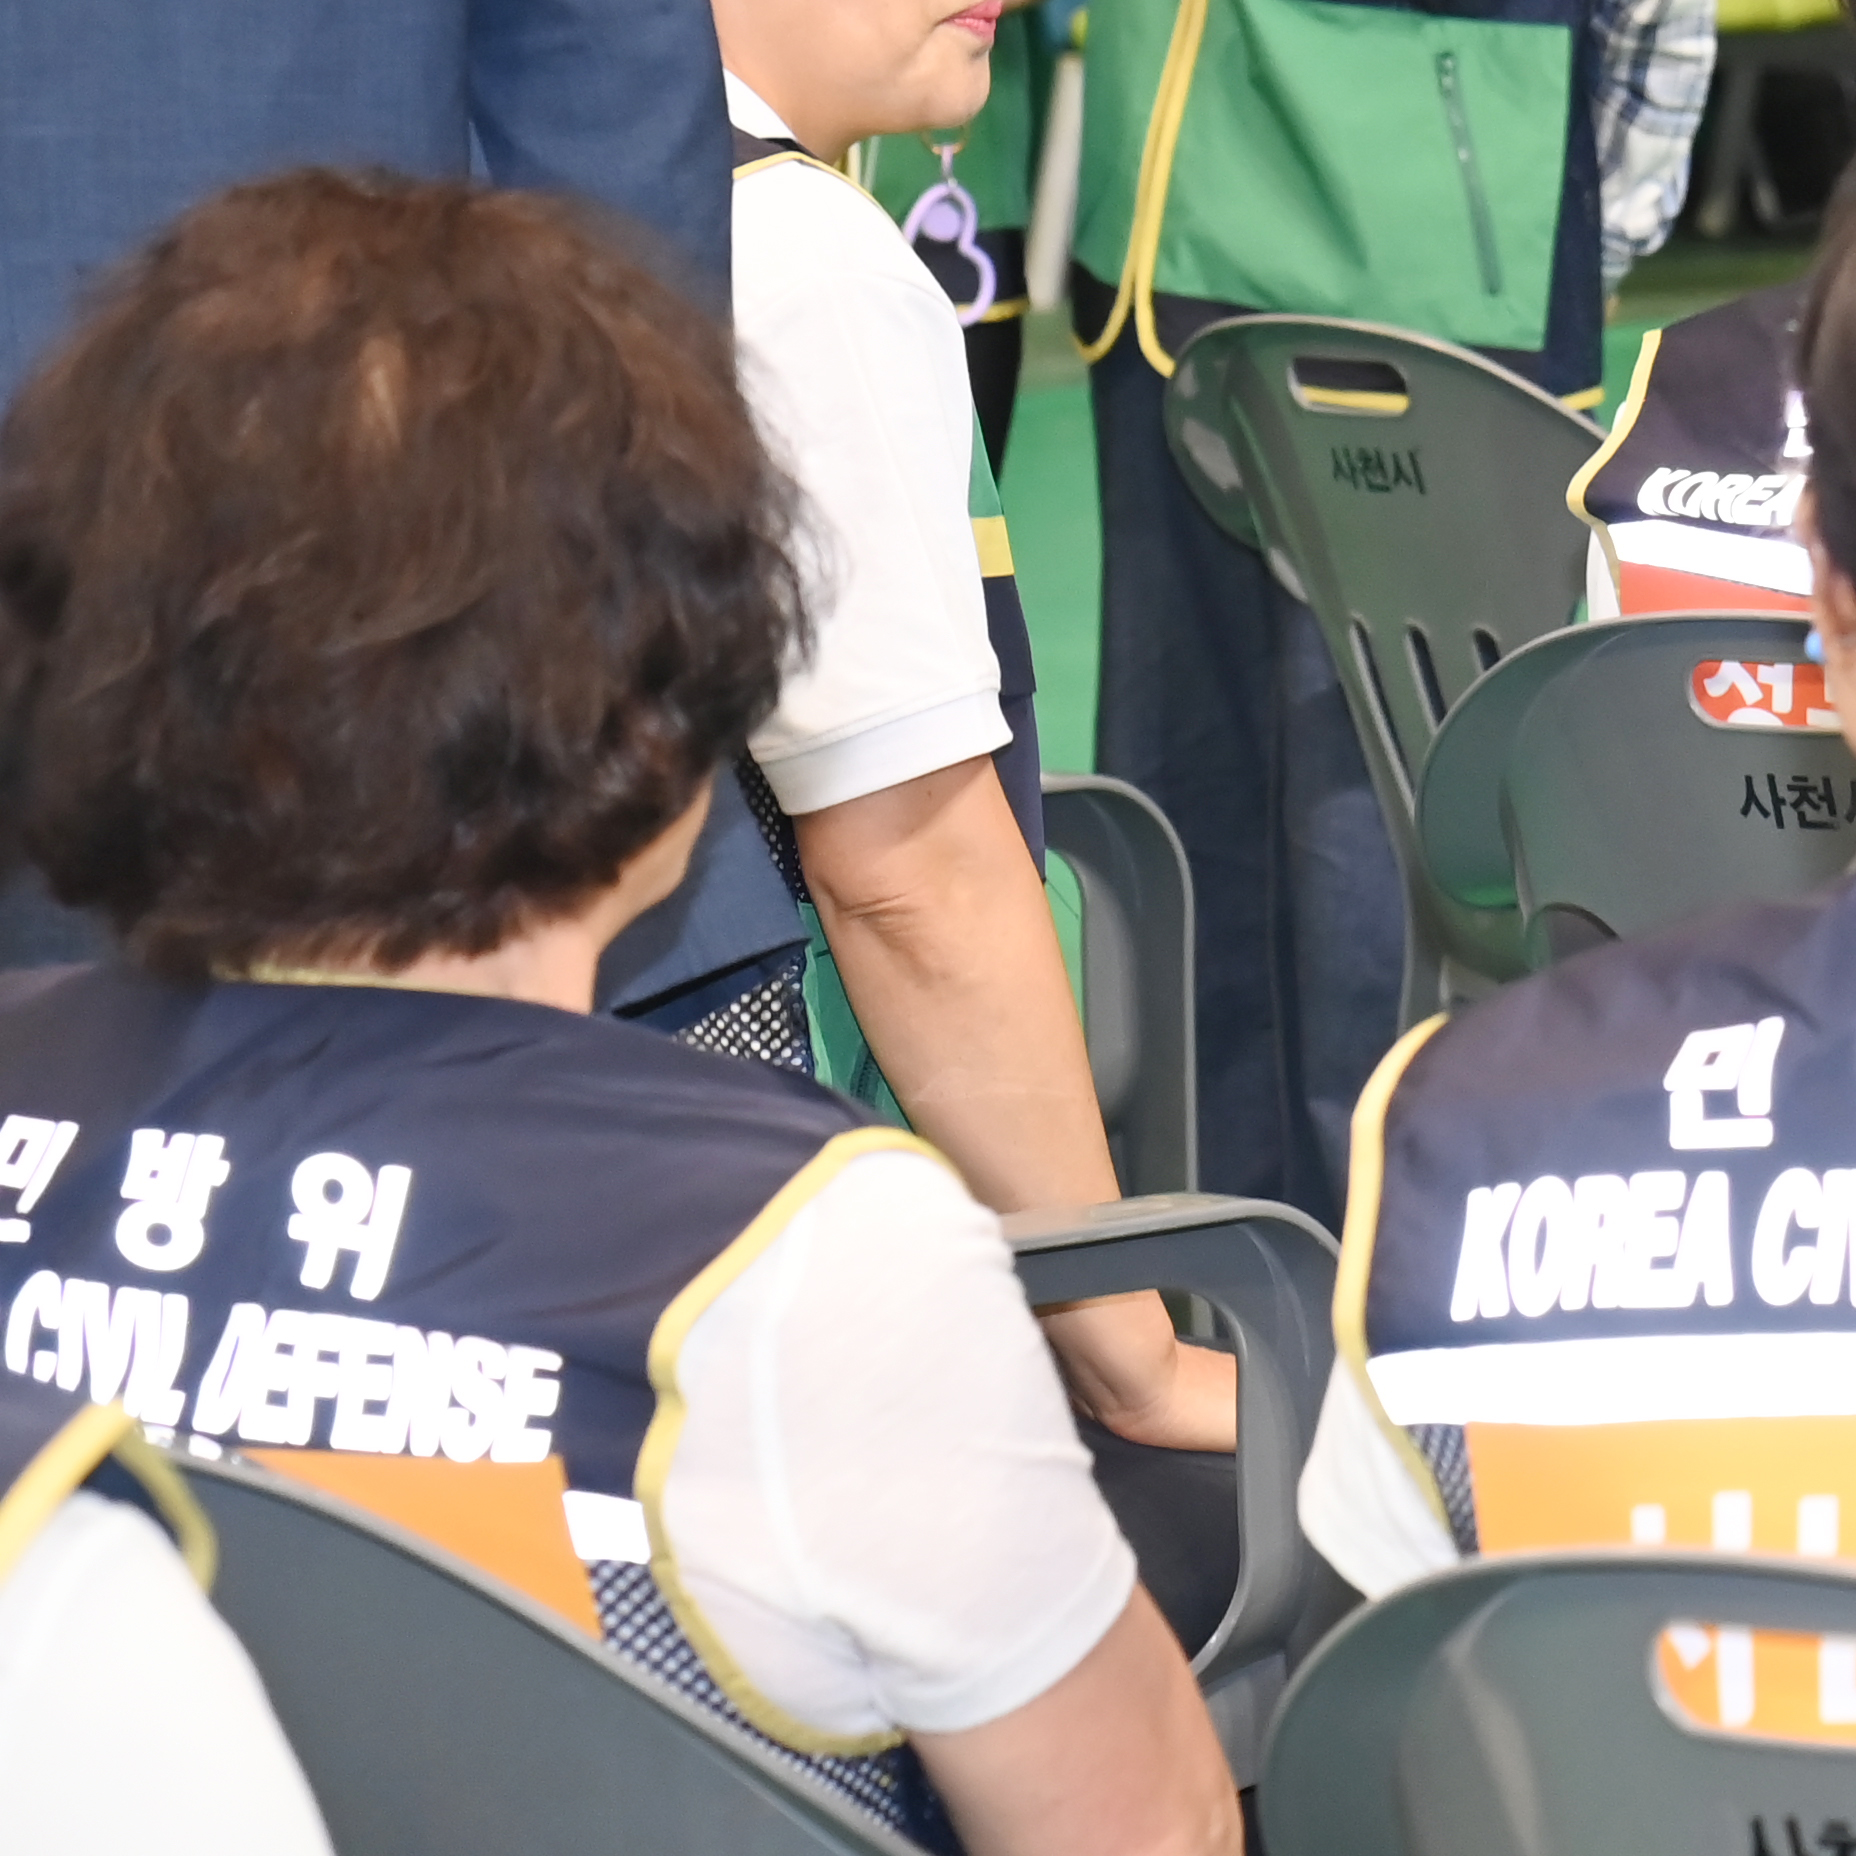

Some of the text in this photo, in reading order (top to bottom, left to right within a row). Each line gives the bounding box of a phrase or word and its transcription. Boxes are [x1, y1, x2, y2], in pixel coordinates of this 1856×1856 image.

[1331, 447, 1426, 495] 사천시
[1449, 1169, 1735, 1322] KOREA
[4, 1270, 562, 1464] CIVIL DEFENSE
